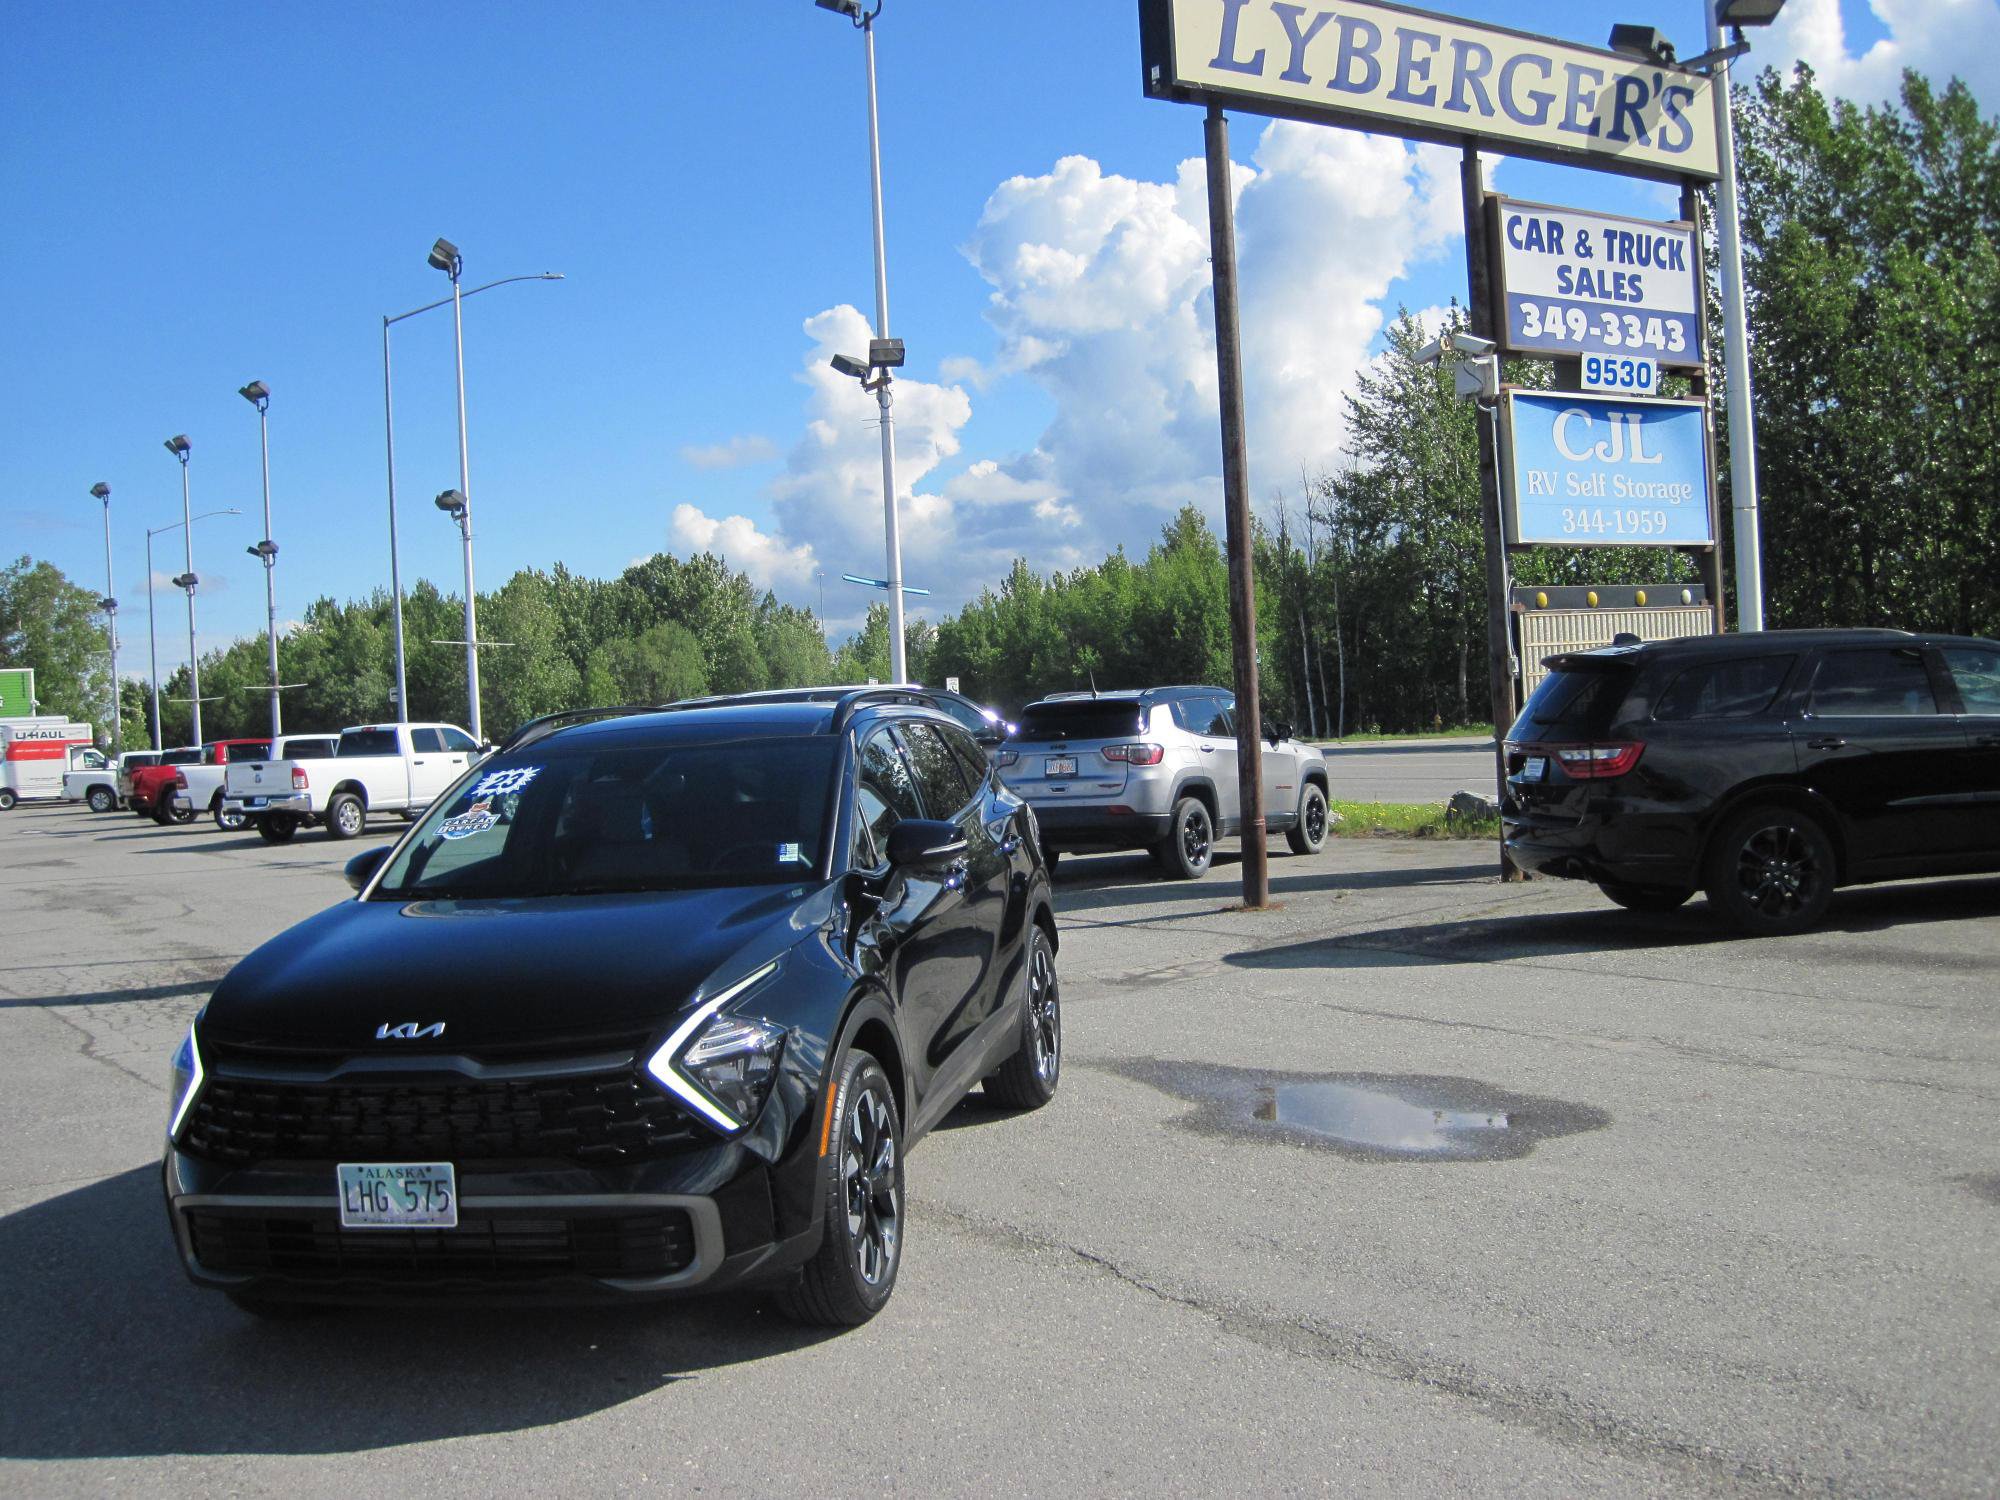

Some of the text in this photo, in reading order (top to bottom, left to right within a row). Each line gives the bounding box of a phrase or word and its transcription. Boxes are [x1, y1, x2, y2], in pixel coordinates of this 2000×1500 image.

[1208, 0, 1694, 153] LYBERGER'S
[1506, 215, 1686, 272] CAR & TRUCK
[1557, 264, 1644, 303] SALES
[1520, 302, 1686, 352] 349-3343
[1586, 357, 1651, 388] 9530
[1552, 408, 1662, 464] CJL
[1527, 470, 1692, 504] RV Self Storage
[1562, 508, 1667, 534] 344-1959
[15, 731, 65, 739] U-HAUL
[366, 1168, 426, 1179] ALASKA
[344, 1180, 450, 1213] LHG 575
